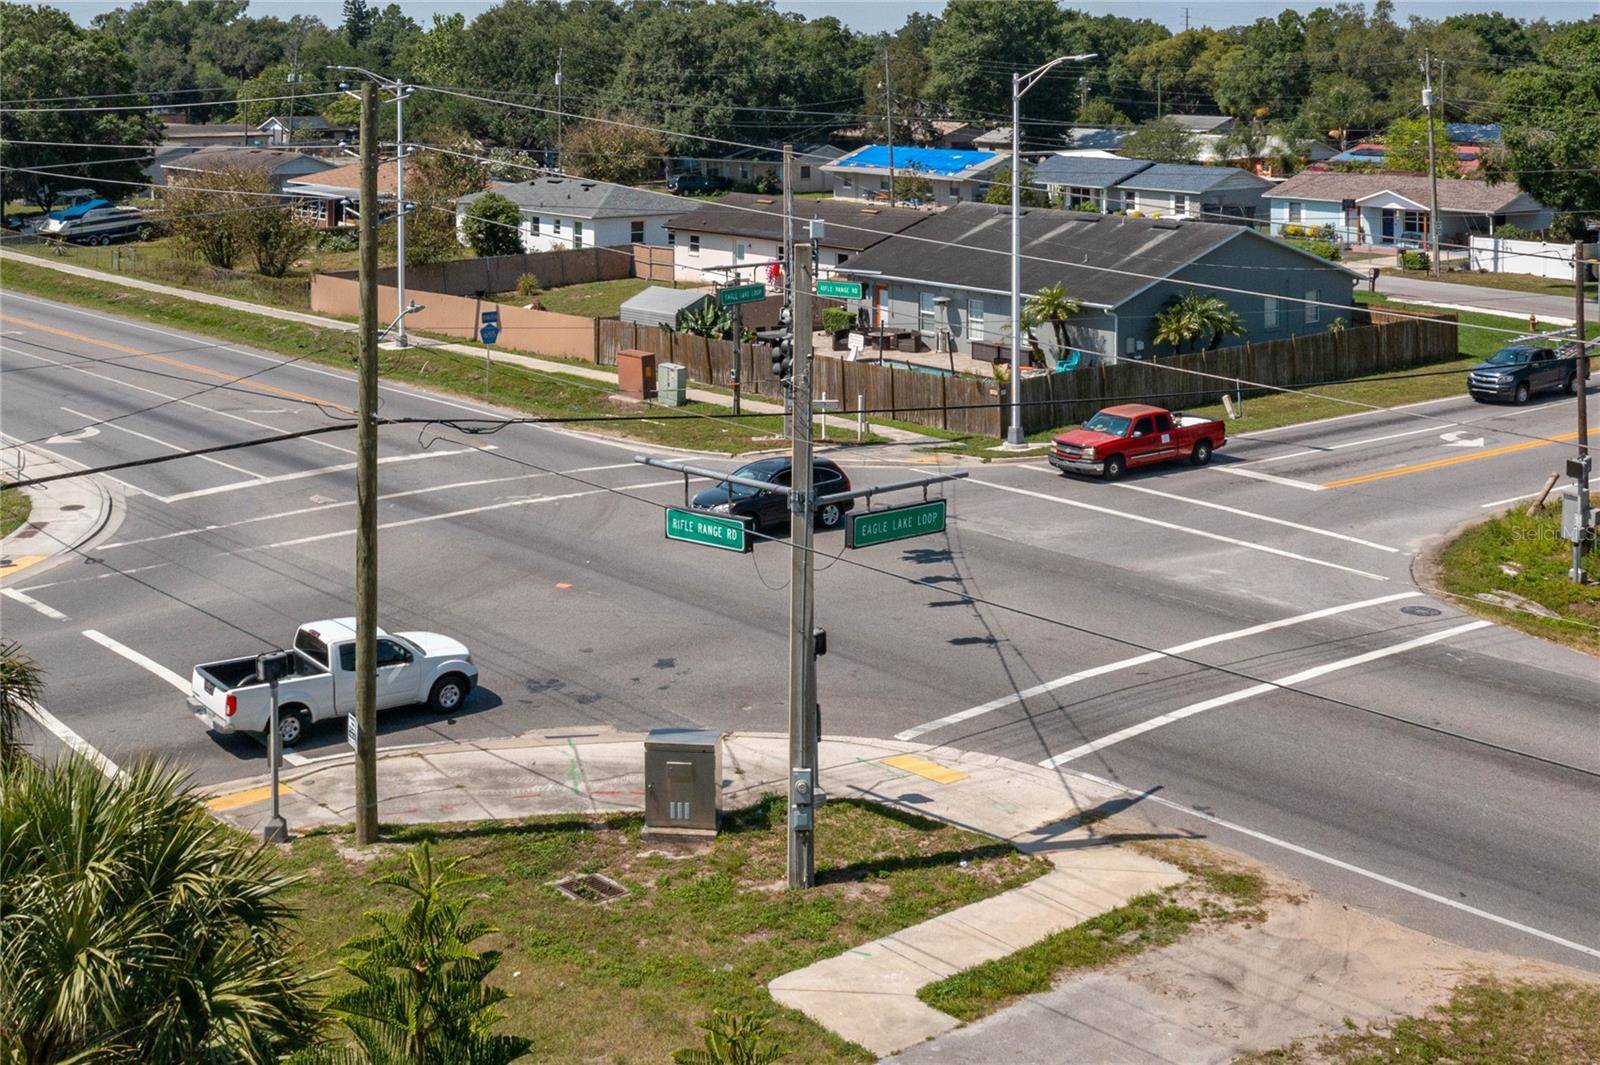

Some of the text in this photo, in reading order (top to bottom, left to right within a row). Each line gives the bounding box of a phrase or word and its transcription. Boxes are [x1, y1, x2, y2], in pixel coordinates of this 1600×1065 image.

[672, 518, 738, 540] RIFLE RANGE RD
[862, 512, 938, 536] EAGLE LAKE LOOP
